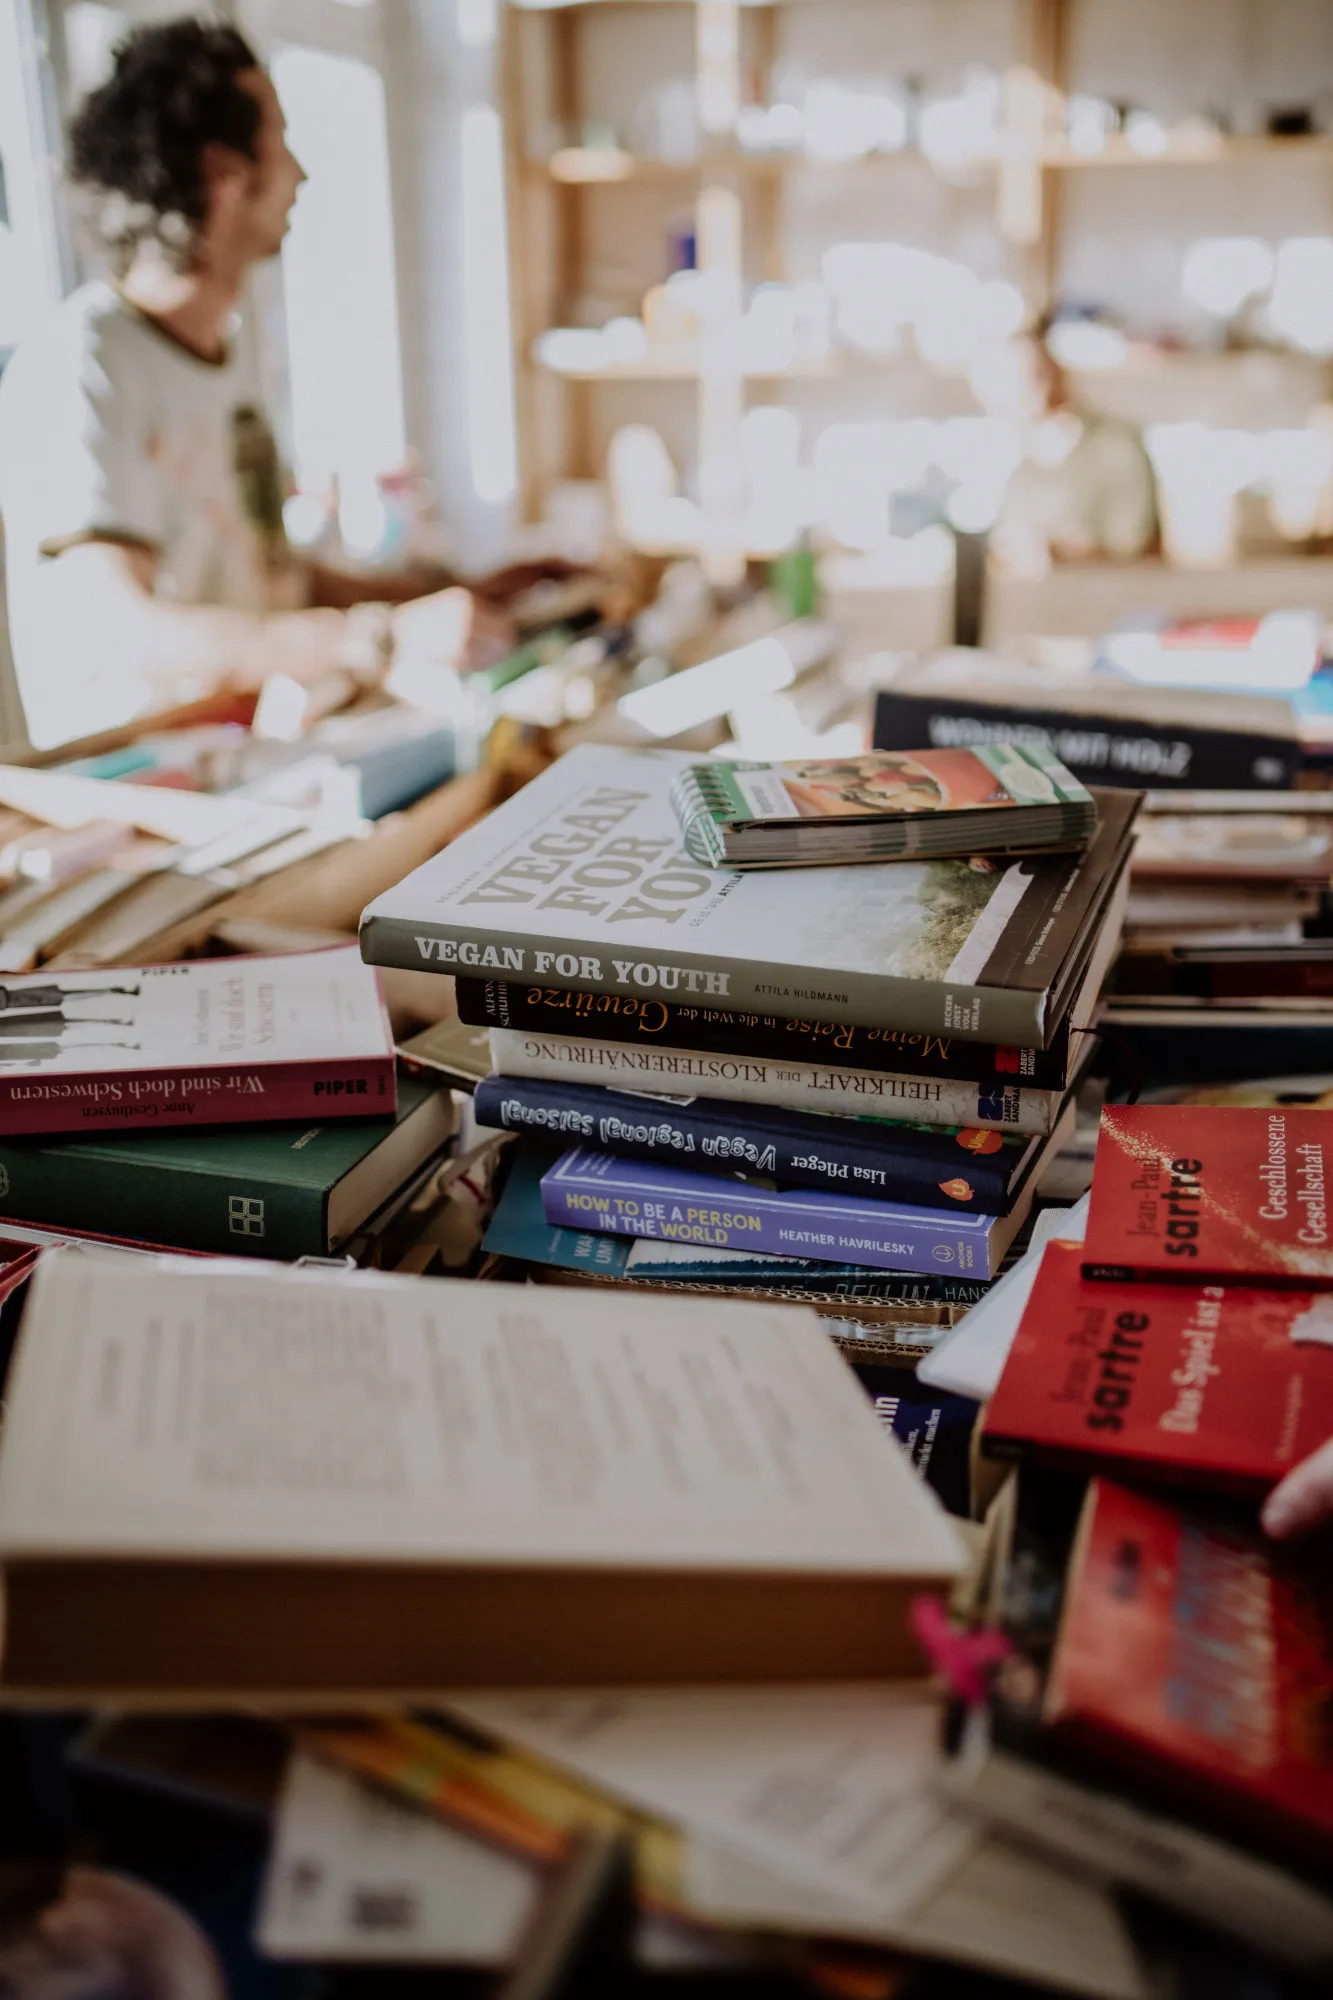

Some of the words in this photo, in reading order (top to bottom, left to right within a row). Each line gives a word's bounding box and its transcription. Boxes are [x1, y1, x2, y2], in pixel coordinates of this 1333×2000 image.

[457, 787, 652, 905] VEGAN
[535, 836, 675, 916] FOR
[415, 936, 525, 971] VEGAN
[534, 951, 603, 981] FOR
[612, 960, 730, 996] YOUTH
[485, 980, 496, 1016] ALFON
[498, 981, 511, 1027] SCHUHB
[527, 987, 669, 1032] Gewürze
[754, 984, 790, 998] ATTILA
[794, 988, 849, 1004] HILDMANN
[677, 1008, 698, 1020] der
[703, 1010, 734, 1023] Welt
[739, 1013, 758, 1027] die
[764, 1018, 776, 1028] in
[944, 994, 953, 1027] BECKER
[962, 1008, 970, 1030] VOLK
[972, 998, 980, 1031] VERLAG
[525, 1040, 768, 1082] KLOSTERERNÄHRUNG
[776, 1070, 800, 1082] DER
[1028, 1048, 1036, 1075] SANDM
[10, 1082, 123, 1102] Schwestern
[128, 1079, 175, 1099] doch
[182, 1077, 221, 1096] sind
[226, 1076, 266, 1093] Wir
[313, 1078, 368, 1096] PIPER
[807, 1072, 942, 1101] HEILKRAFT
[162, 1102, 196, 1115] Anne
[500, 1100, 594, 1136] saisonal
[1004, 1095, 1013, 1123] ZABERT
[1011, 1088, 1021, 1123] SANDMA
[600, 1116, 695, 1152] regional
[702, 1135, 777, 1171] Vegan
[790, 1156, 849, 1178] Pfleger
[1258, 1115, 1288, 1221] Geschlossene
[853, 1165, 887, 1185] Lisa
[1126, 1157, 1161, 1237] Jean-Paul
[1161, 1158, 1203, 1257] sartre
[1296, 1143, 1328, 1244] Gesellschaft
[566, 1193, 610, 1213] HOW
[614, 1199, 639, 1216] TO
[644, 1202, 666, 1220] BE
[671, 1206, 684, 1222] A
[688, 1208, 762, 1231] PERSON
[599, 1213, 617, 1229] IN
[621, 1216, 658, 1235] THE
[660, 1222, 728, 1244] WORLD
[780, 1229, 835, 1245] HEATHER
[839, 1236, 915, 1255] HAVRILESKY
[1086, 1310, 1150, 1434] sartre
